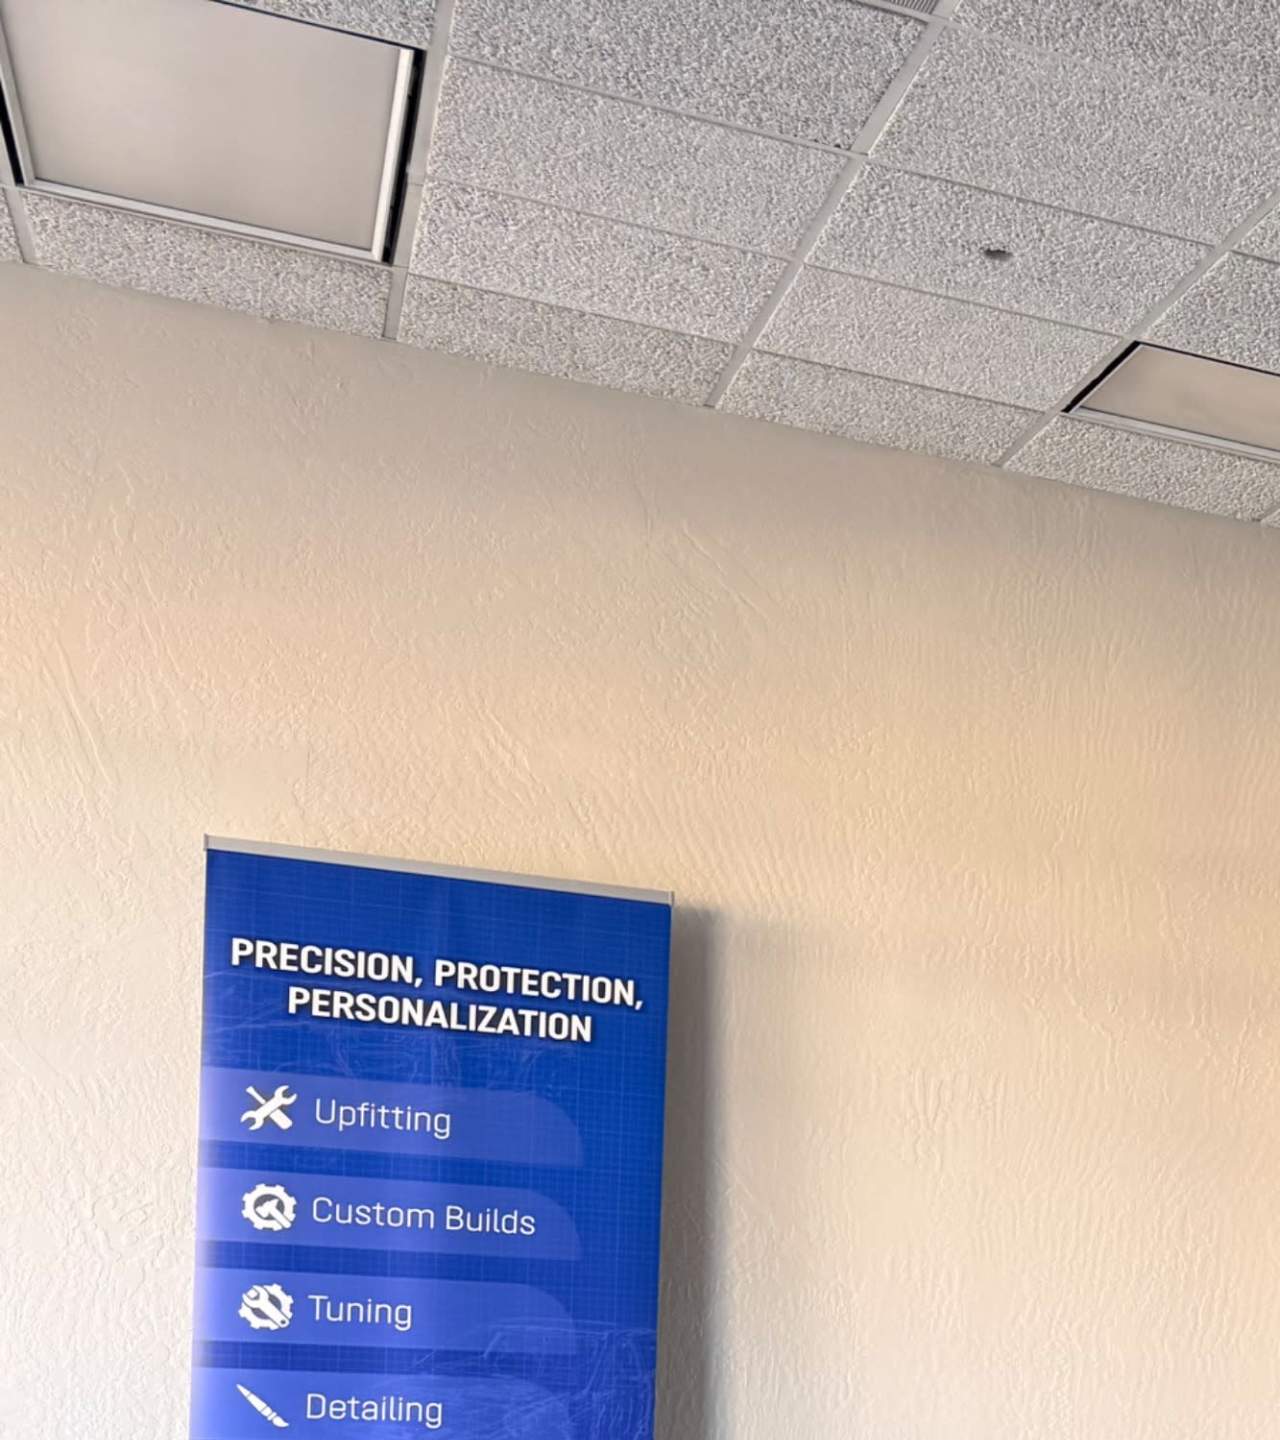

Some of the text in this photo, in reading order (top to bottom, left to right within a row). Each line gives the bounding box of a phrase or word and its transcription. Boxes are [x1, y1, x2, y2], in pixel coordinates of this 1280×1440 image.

[231, 937, 645, 1010] PRECISION, PROTECTION,
[287, 986, 593, 1042] PERSONALIZATION
[315, 1098, 452, 1140] Upfitting
[312, 1196, 536, 1236] Custom Builds
[308, 1294, 413, 1331] Tuning
[306, 1393, 443, 1429] Detailing
